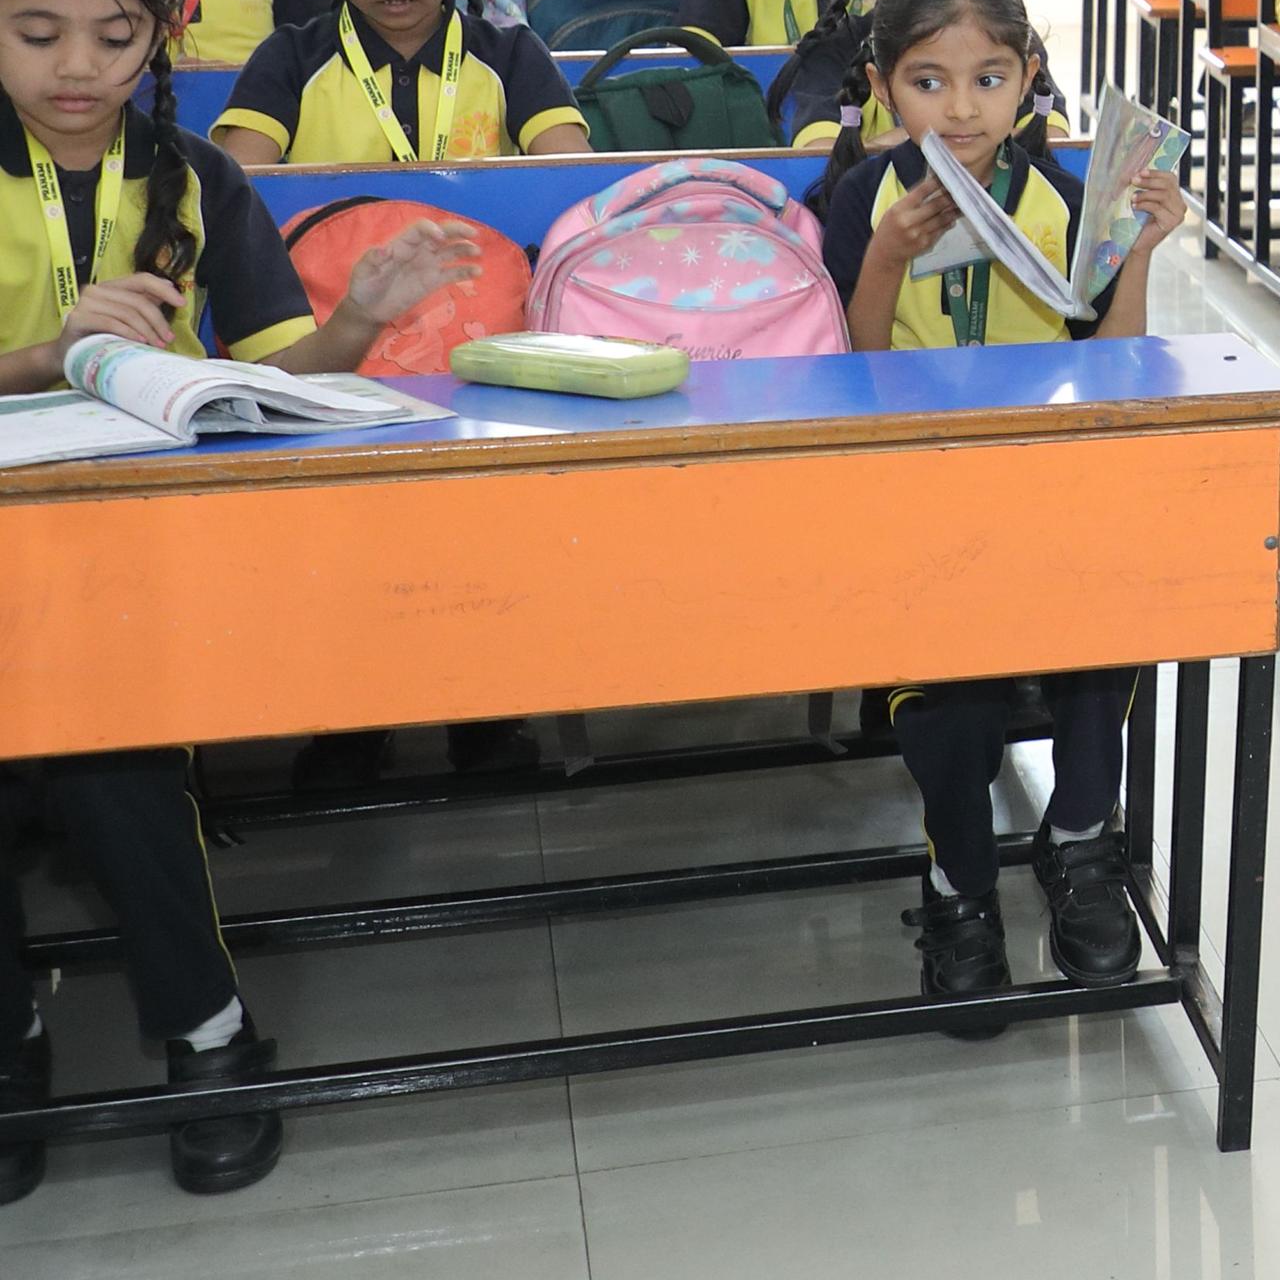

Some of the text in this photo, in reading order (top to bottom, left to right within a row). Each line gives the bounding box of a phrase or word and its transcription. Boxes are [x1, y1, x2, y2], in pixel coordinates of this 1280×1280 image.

[363, 78, 380, 107] PRANAMI
[36, 163, 51, 201] PRANAMI
[57, 267, 69, 306] PRANAMI
